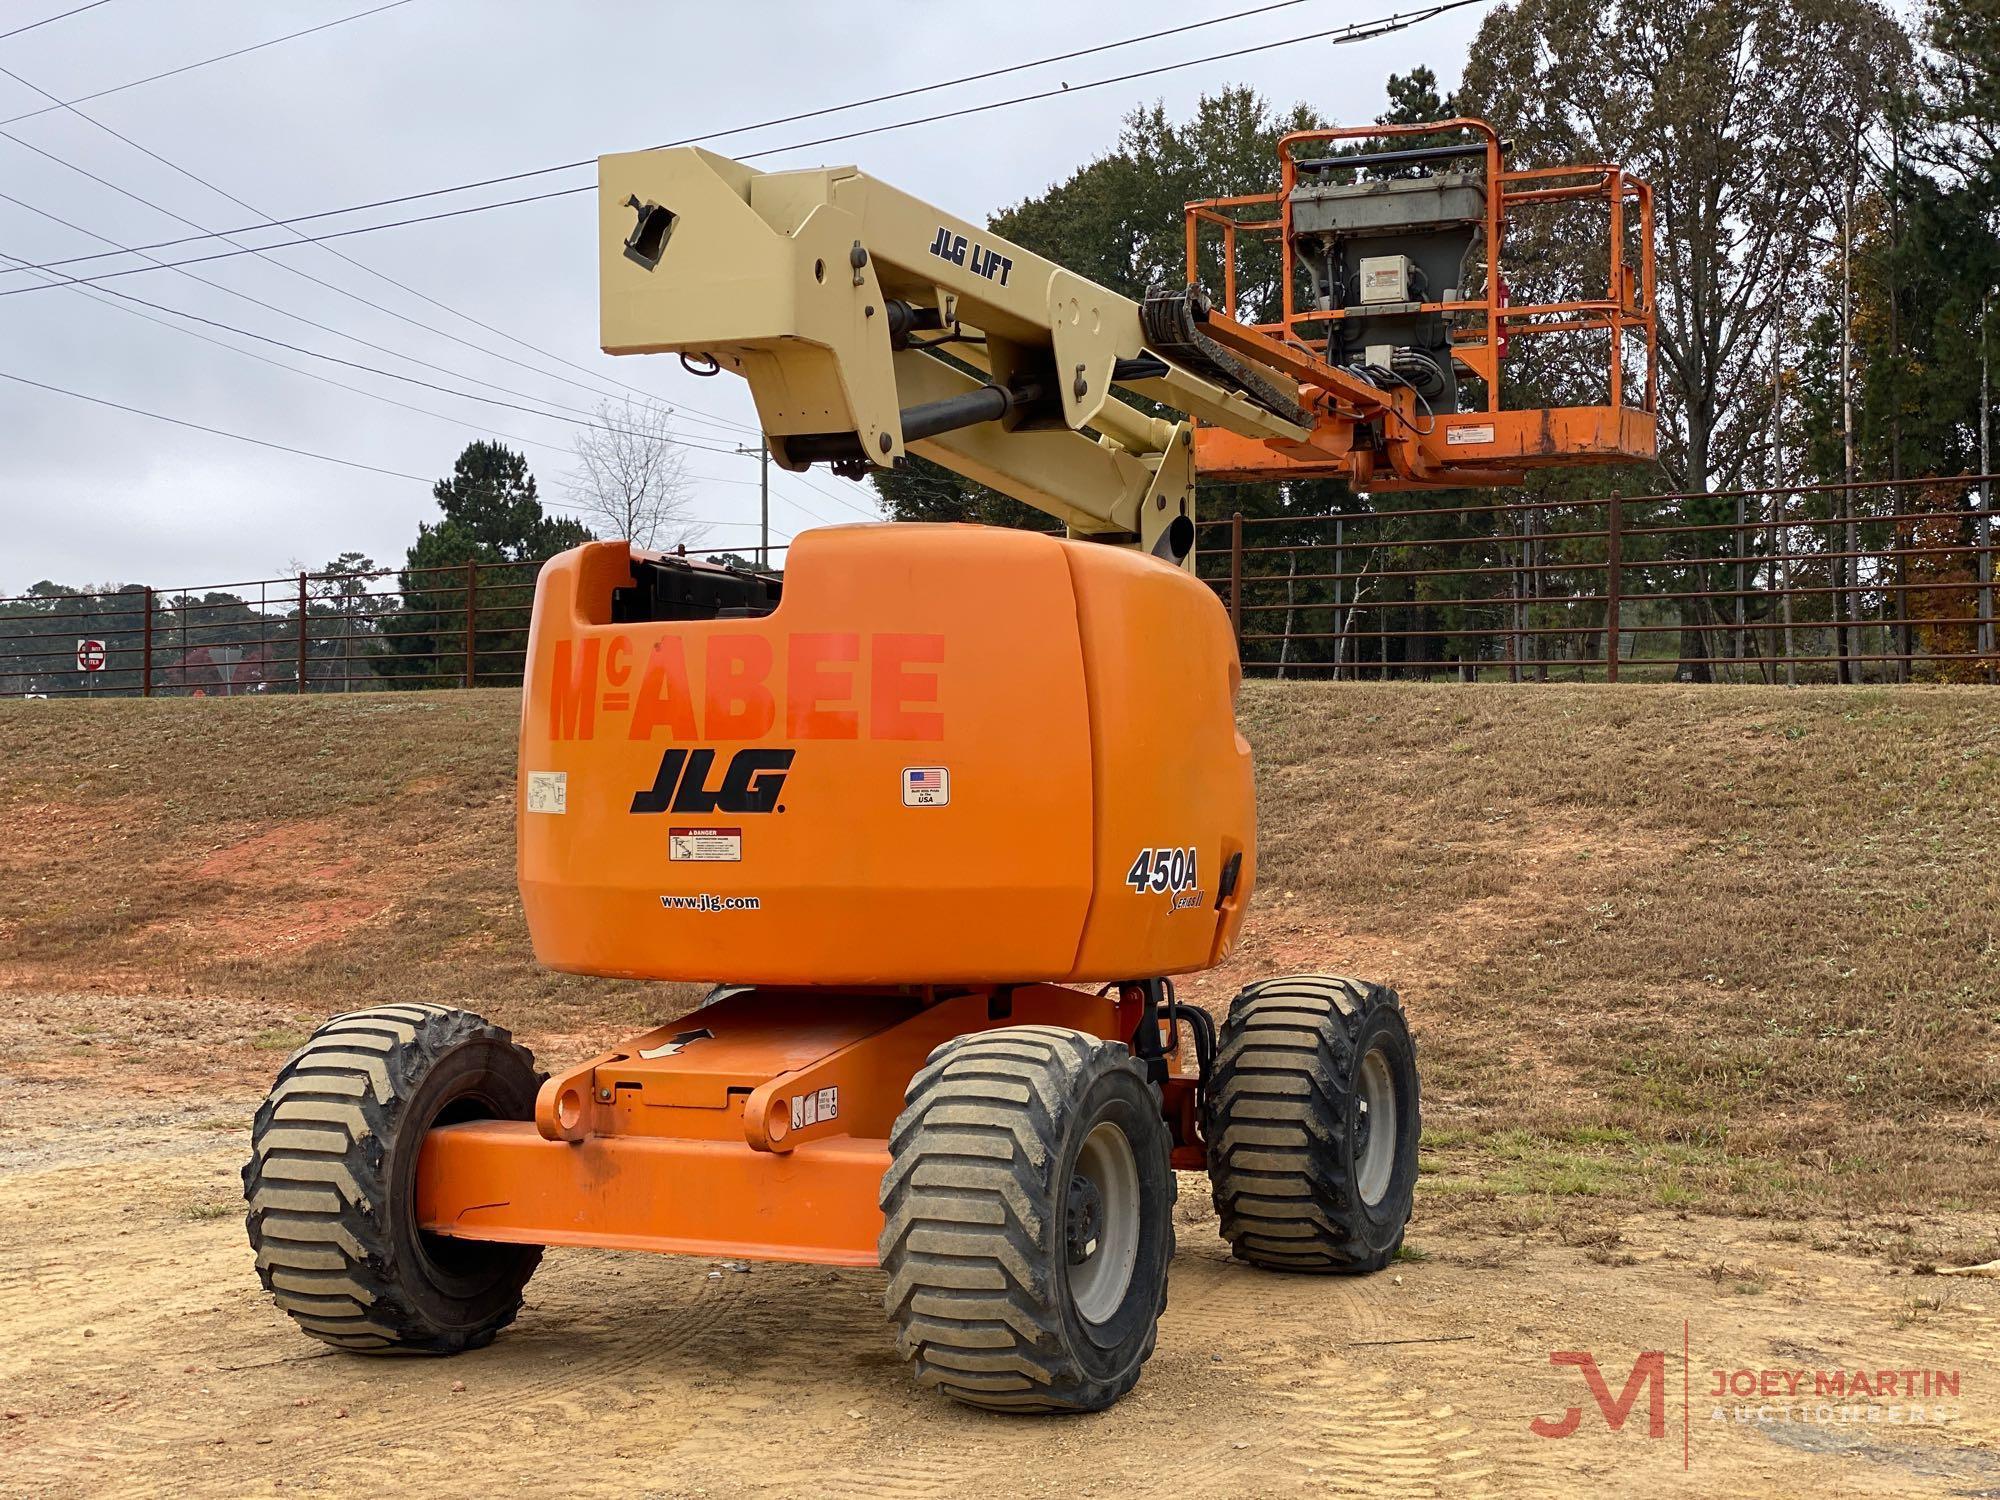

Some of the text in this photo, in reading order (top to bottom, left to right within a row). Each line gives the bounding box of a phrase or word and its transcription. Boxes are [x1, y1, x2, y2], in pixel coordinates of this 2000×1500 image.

[929, 226, 1013, 287] JLG LIFT
[1126, 847, 1198, 894] 450A
[660, 894, 760, 912] www.jlg.com
